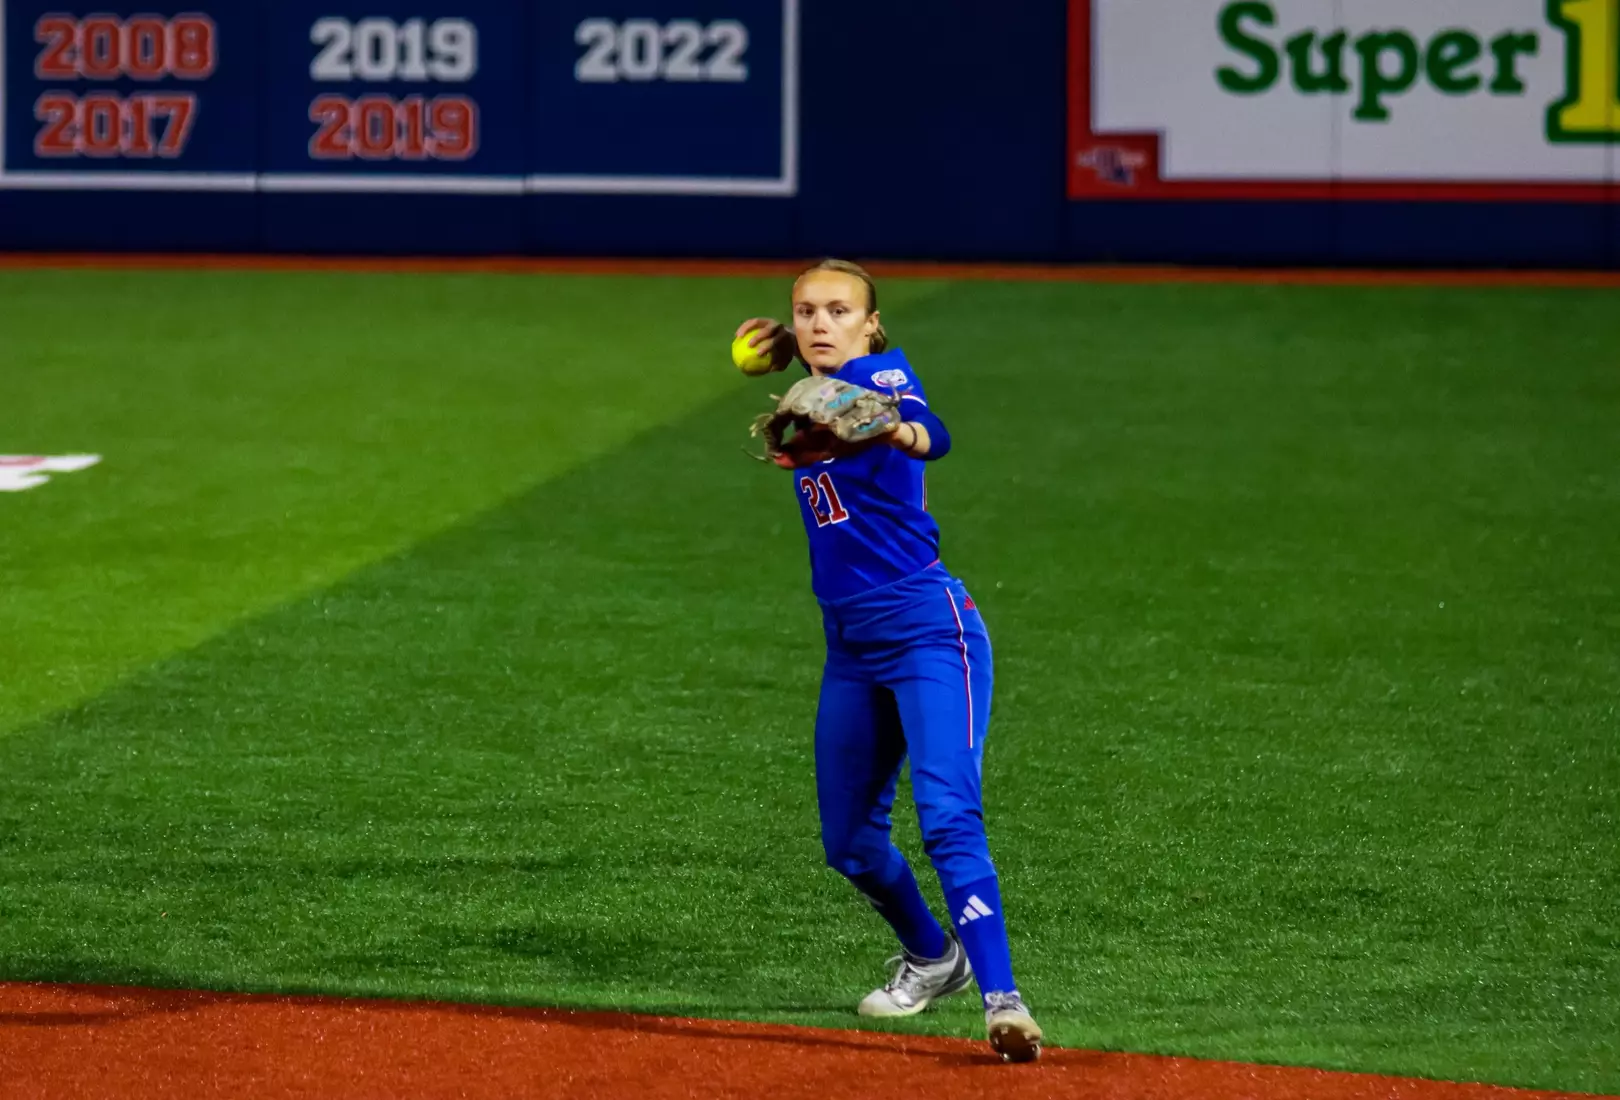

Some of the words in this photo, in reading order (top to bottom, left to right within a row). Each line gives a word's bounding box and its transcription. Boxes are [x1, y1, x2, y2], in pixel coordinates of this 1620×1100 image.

[34, 13, 215, 80] 2008
[310, 18, 478, 82] 2019
[575, 19, 748, 82] 2022
[1214, 0, 1540, 122] Super
[34, 92, 197, 157] 2017
[308, 96, 479, 159] 2019
[801, 472, 849, 527] 21
